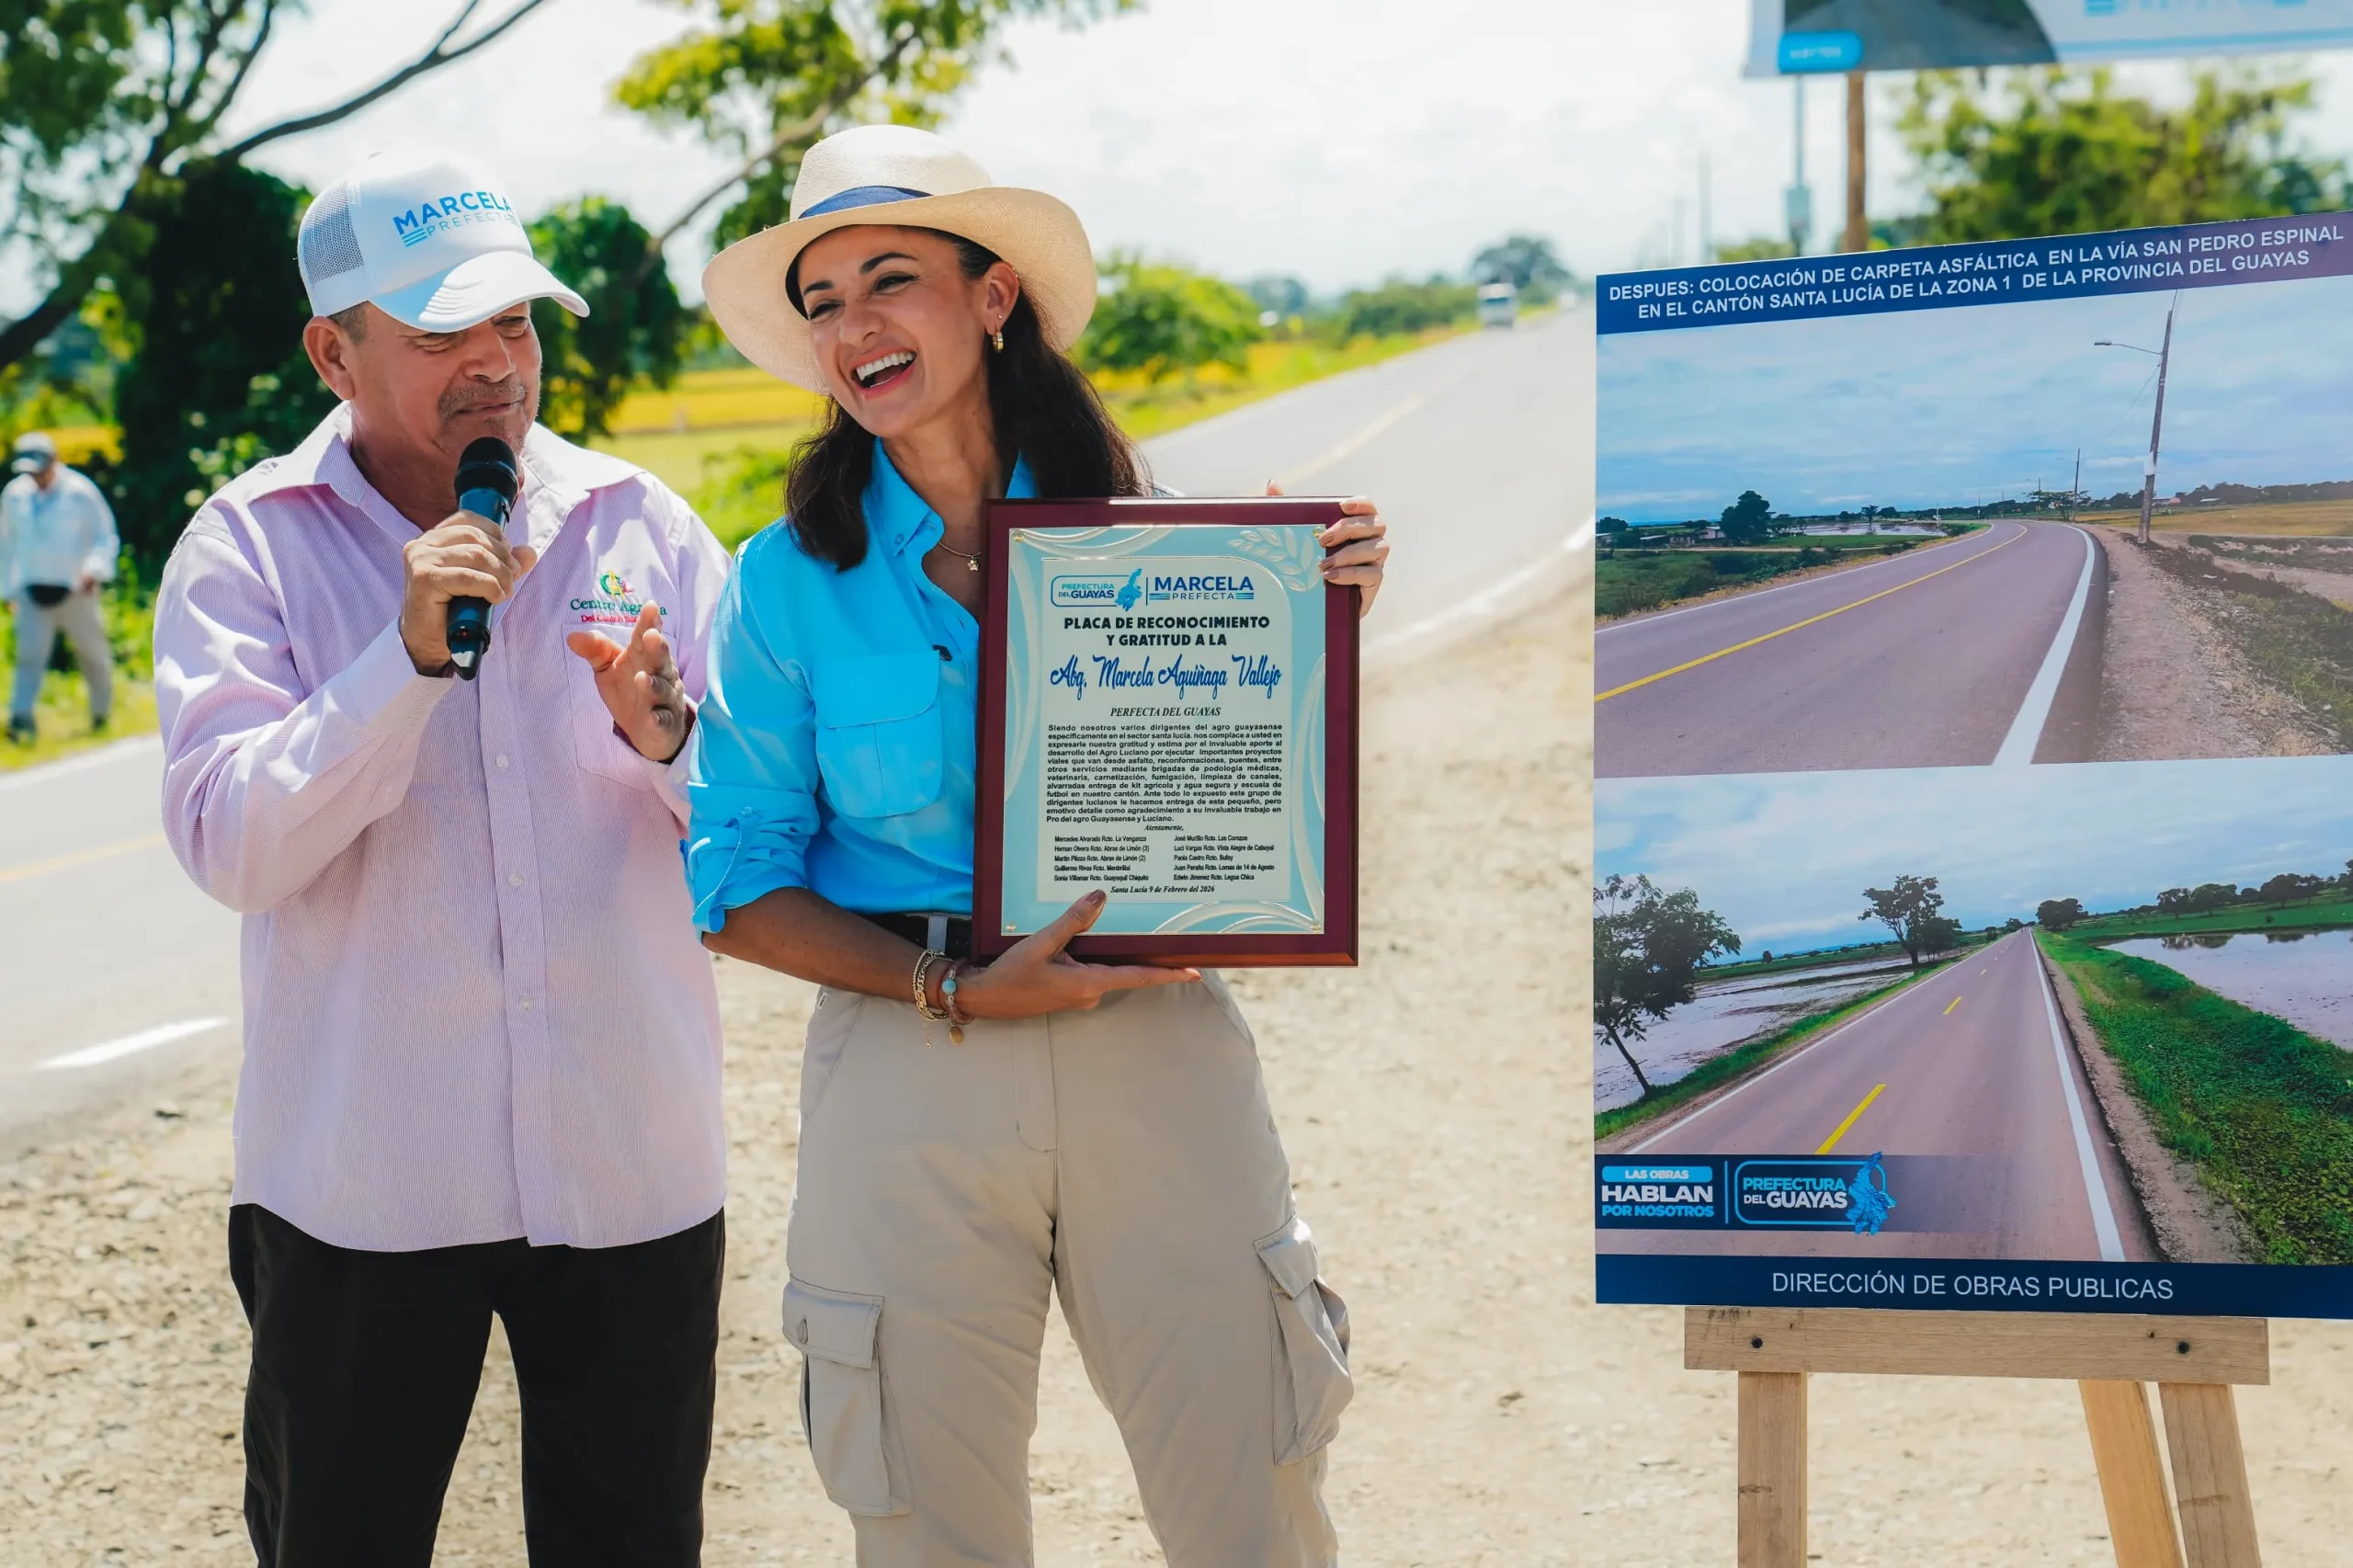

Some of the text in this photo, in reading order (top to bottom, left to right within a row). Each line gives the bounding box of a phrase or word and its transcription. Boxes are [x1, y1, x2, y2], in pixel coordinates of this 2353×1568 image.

[392, 191, 512, 235] MARCELA
[426, 211, 510, 236] PREFECTA
[1609, 225, 2343, 301] DESPUES: COLOCACIÓN DE CARPETA ASFÁLTICA EN LA VÍA SAN PEDRO ESPINAL
[1638, 250, 2309, 318] EN EL CANTÓN SANTA LUCÍA DE LA ZONA 1 DE LA PROVINCIA DEL GUAYAS
[1154, 575, 1254, 591] MARCELA
[1071, 589, 1114, 599] GUAYAS
[1064, 617, 1269, 629] PLACA DE RECONOCIMIENTO
[1107, 635, 1226, 645] Y GRATITUD A LA
[1050, 654, 1086, 700] Abg.
[1093, 654, 1154, 689] Marcela
[1232, 654, 1281, 699] Vallejo
[1110, 707, 1221, 716] PERFECTA DEL GUAYAS
[1151, 724, 1190, 733] dirigentes
[1099, 749, 1118, 757] Agro
[1151, 749, 1164, 757] por
[1165, 749, 1195, 757] ejecutar
[1199, 748, 1243, 756] importantes
[1245, 748, 1281, 756] proyectos
[1129, 757, 1154, 766] asfalto,
[1229, 756, 1260, 765] puentes,
[1152, 766, 1186, 774] brigadas
[1247, 765, 1281, 773] médicas,
[1152, 774, 1196, 782] fumigación,
[1200, 773, 1232, 781] limpieza
[1250, 773, 1281, 781] canales,
[1088, 782, 1116, 790] entrega
[1176, 782, 1180, 790] y
[1047, 799, 1083, 807] dirigentes
[1166, 799, 1194, 807] entrega
[1228, 798, 1261, 806] pequeño,
[1091, 815, 1136, 824] Guayasense
[1625, 1170, 1688, 1179] LAS OBRAS
[1743, 1177, 1847, 1191] PREFECTURA
[1601, 1186, 1712, 1202] HABLAN
[1744, 1191, 1847, 1208] DEL GUAYAS
[1602, 1206, 1714, 1217] POR NOSOTROS
[1773, 1270, 2173, 1300] DIRECCIÓN DE OBRAS PUBLICAS
